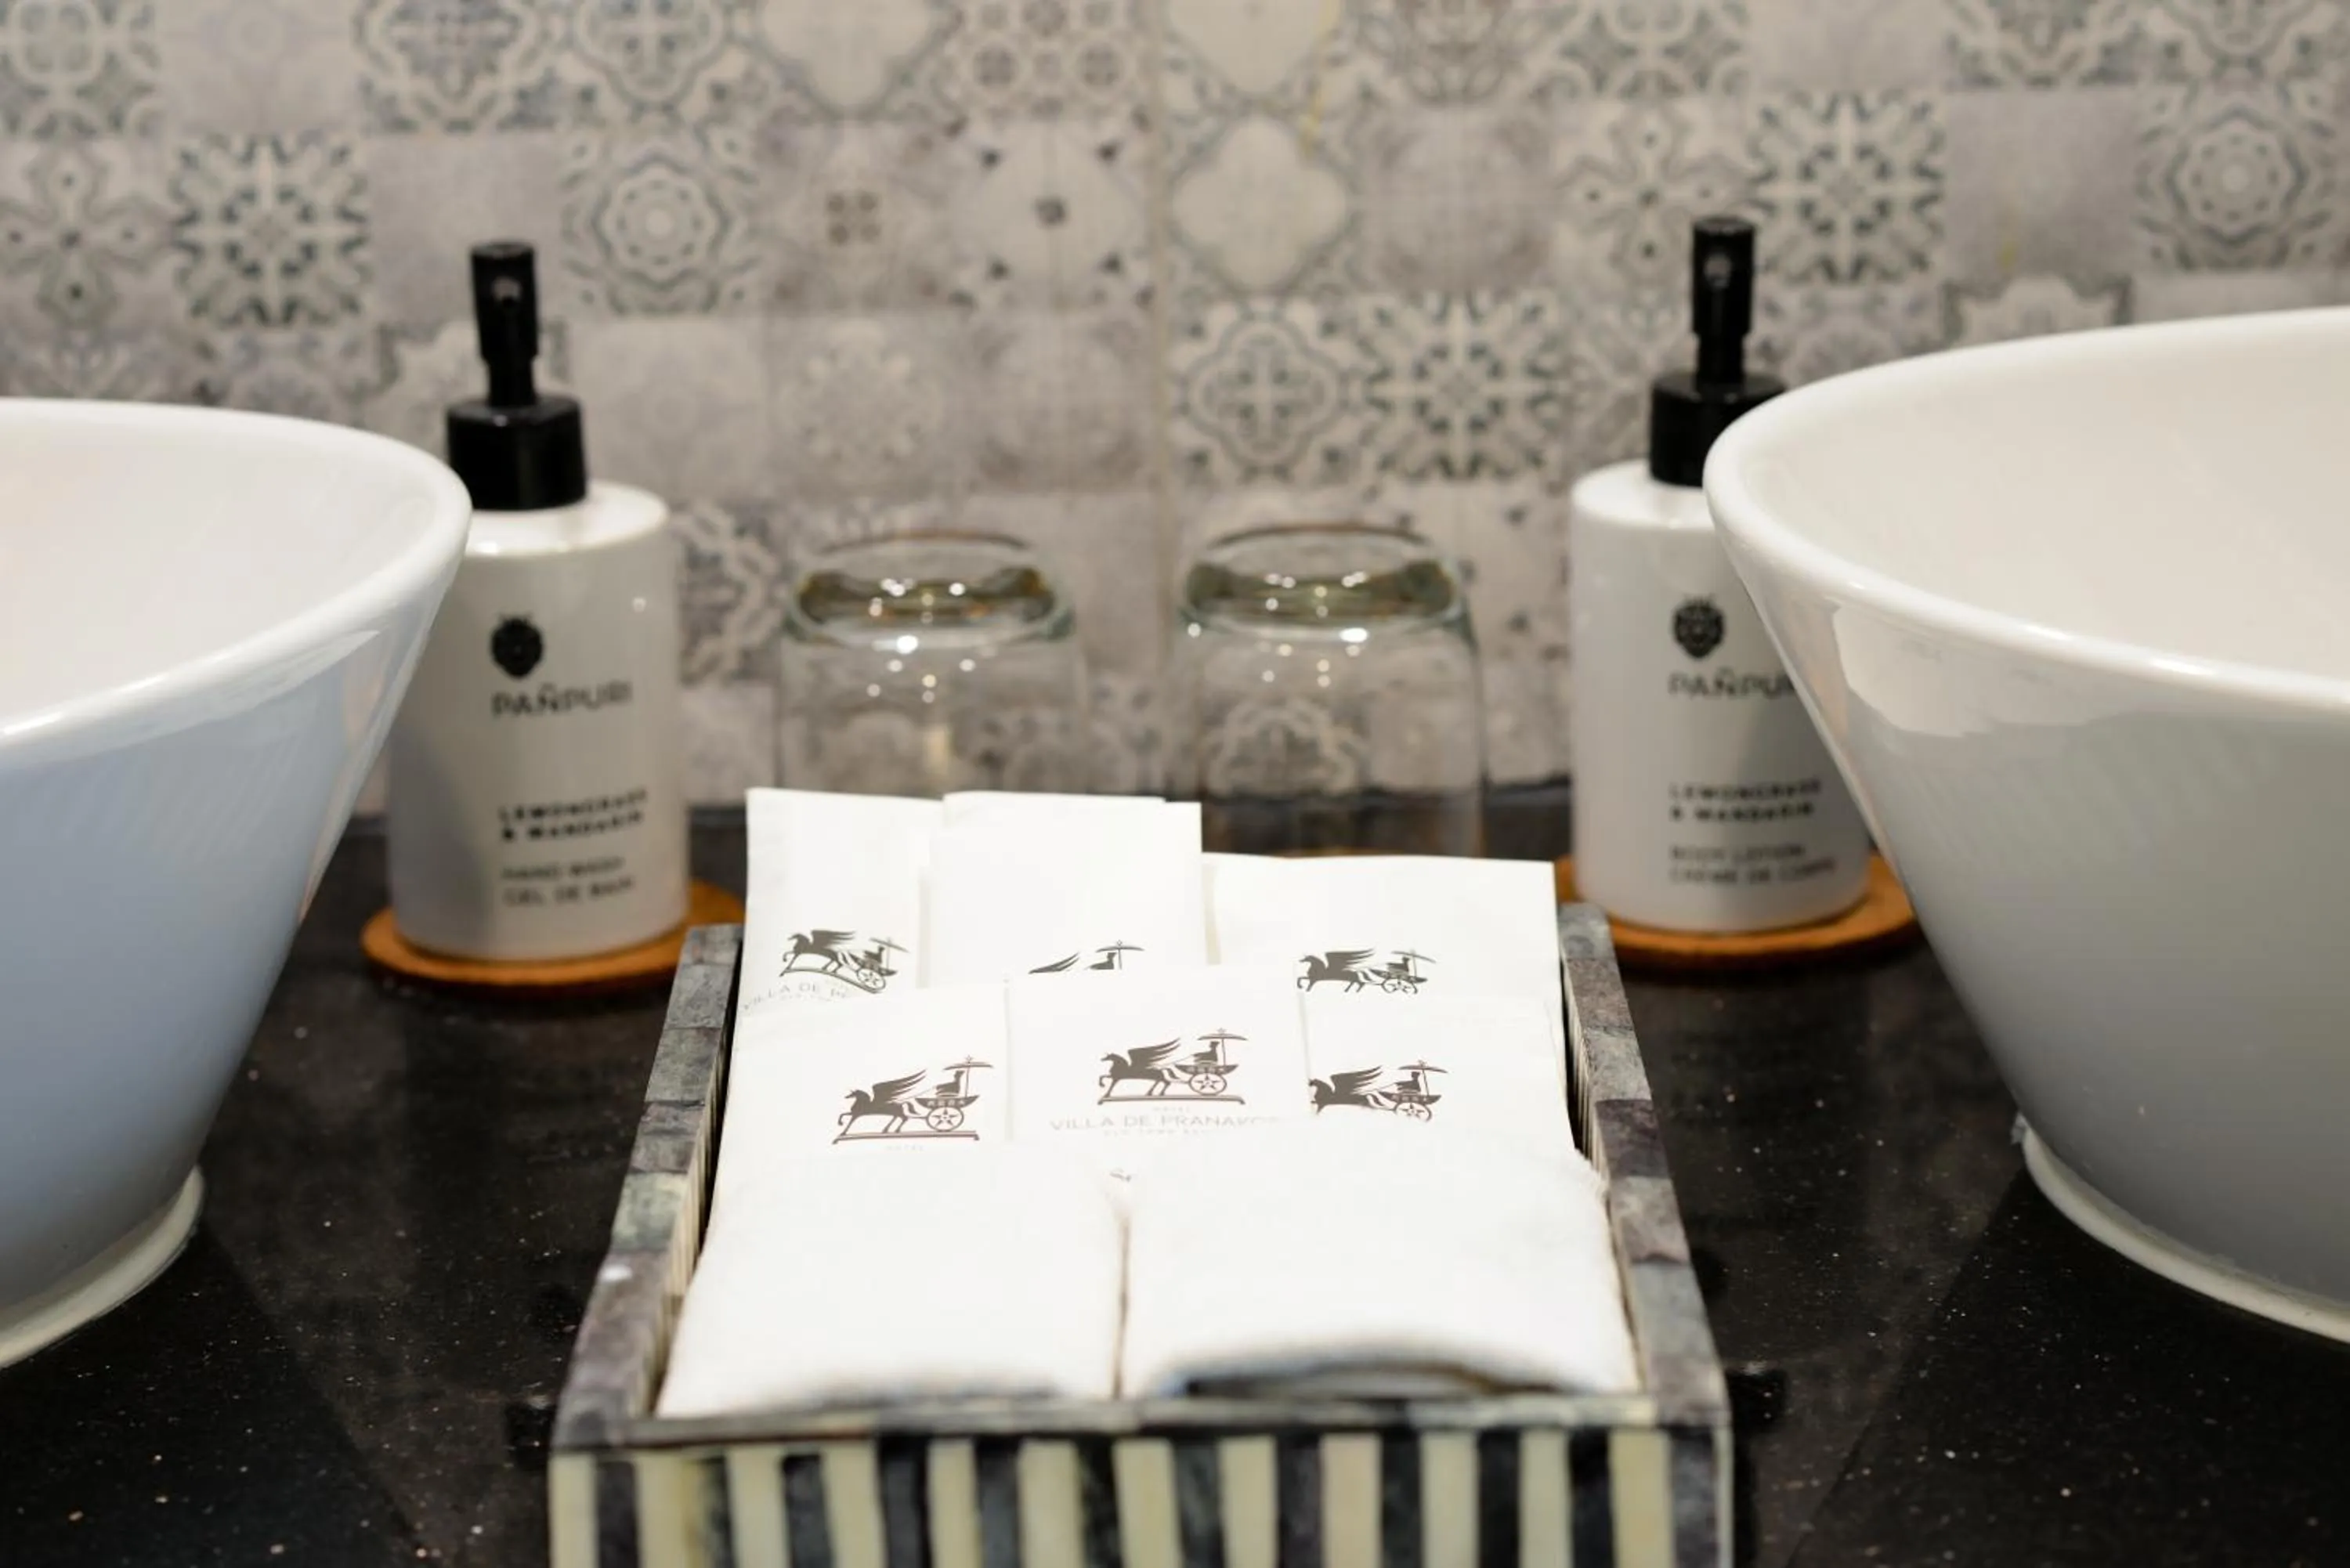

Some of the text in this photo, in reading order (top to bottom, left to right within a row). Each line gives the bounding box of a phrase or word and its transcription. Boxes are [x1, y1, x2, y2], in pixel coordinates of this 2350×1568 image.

[491, 681, 632, 716] PAÑPURI
[1668, 668, 1796, 699] PAÑPUR
[1050, 1115, 1114, 1130] VILLA
[1124, 1115, 1147, 1127] DE
